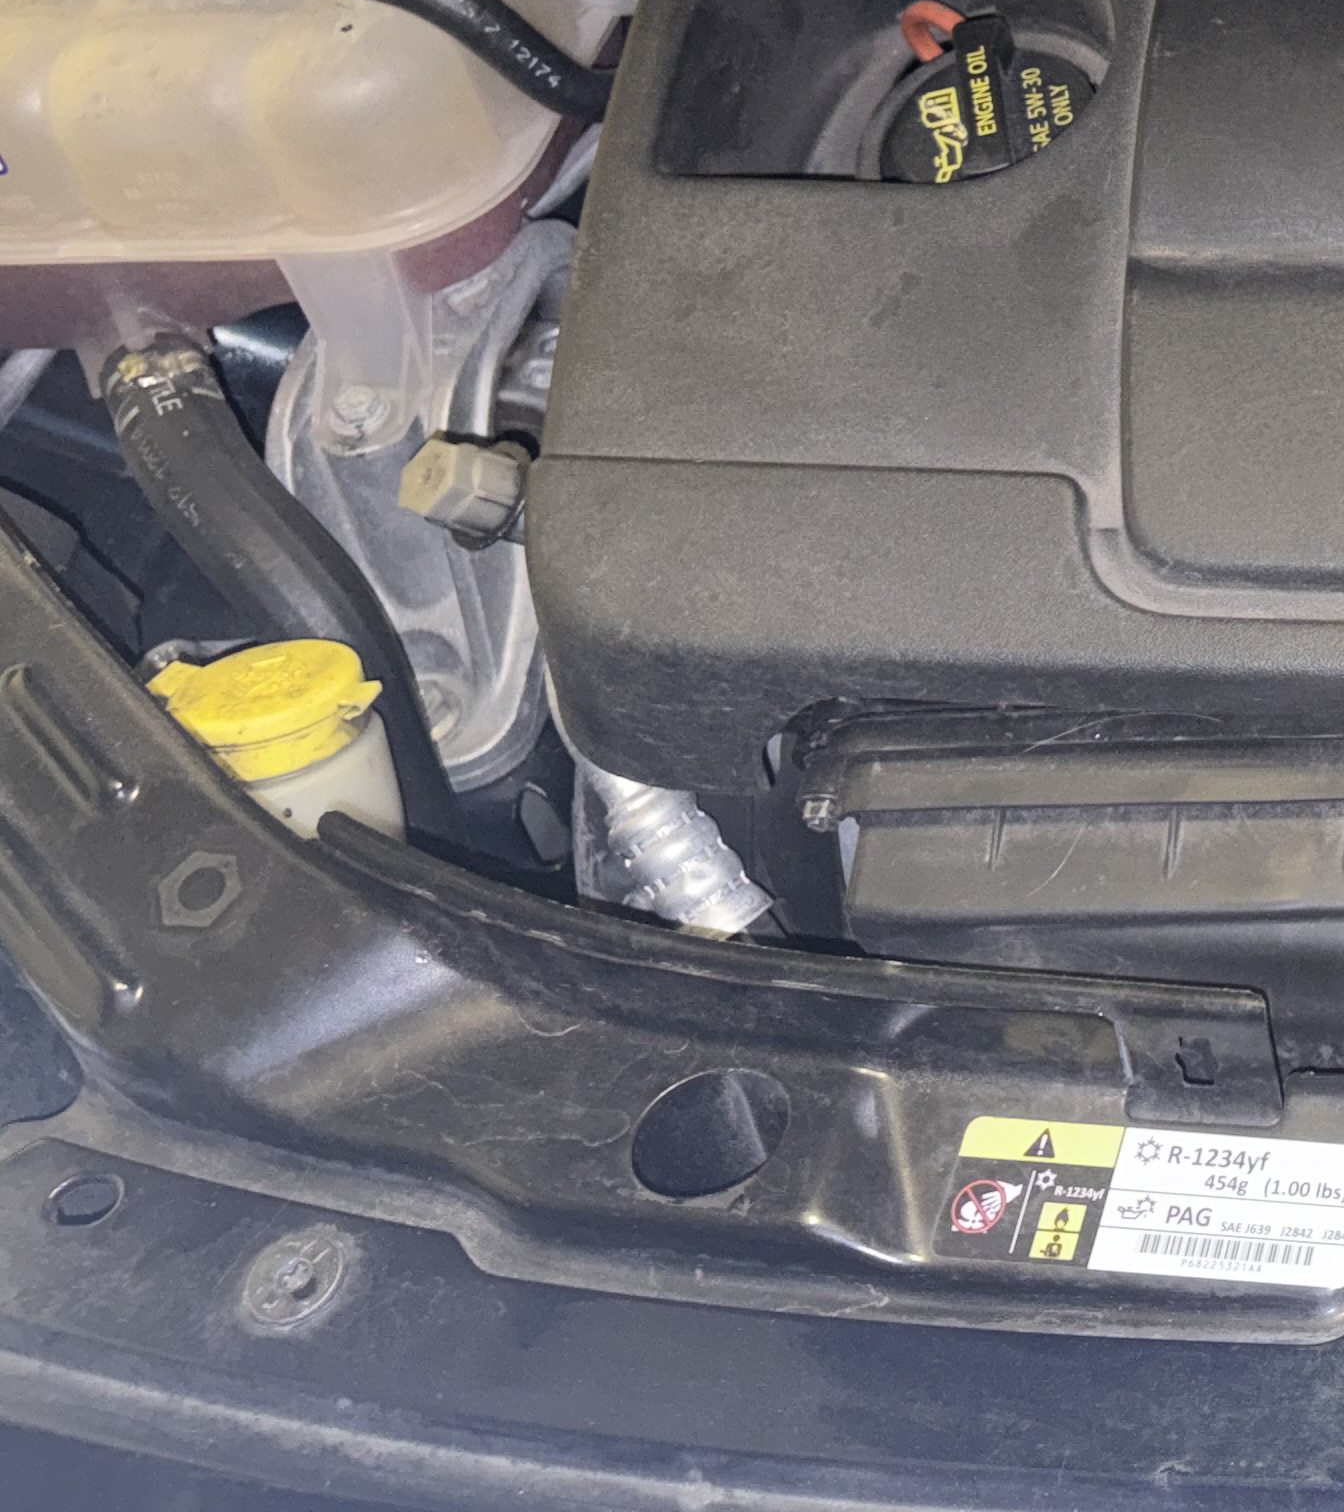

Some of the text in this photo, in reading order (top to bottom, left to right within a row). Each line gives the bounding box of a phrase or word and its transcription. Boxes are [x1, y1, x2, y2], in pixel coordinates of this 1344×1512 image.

[966, 45, 997, 136] ENGINE OIL
[1021, 67, 1047, 120] 5W-30
[1048, 84, 1073, 126] ONLY
[1165, 1145, 1270, 1174] R-1234yf
[1053, 1185, 1106, 1202] R-1234yf
[1202, 1173, 1250, 1195] 454g
[1262, 1178, 1311, 1200] (1.00
[1164, 1205, 1213, 1227] PAG
[1219, 1222, 1243, 1232] SAE
[1244, 1224, 1271, 1235] J639
[1279, 1227, 1313, 1239] J2842
